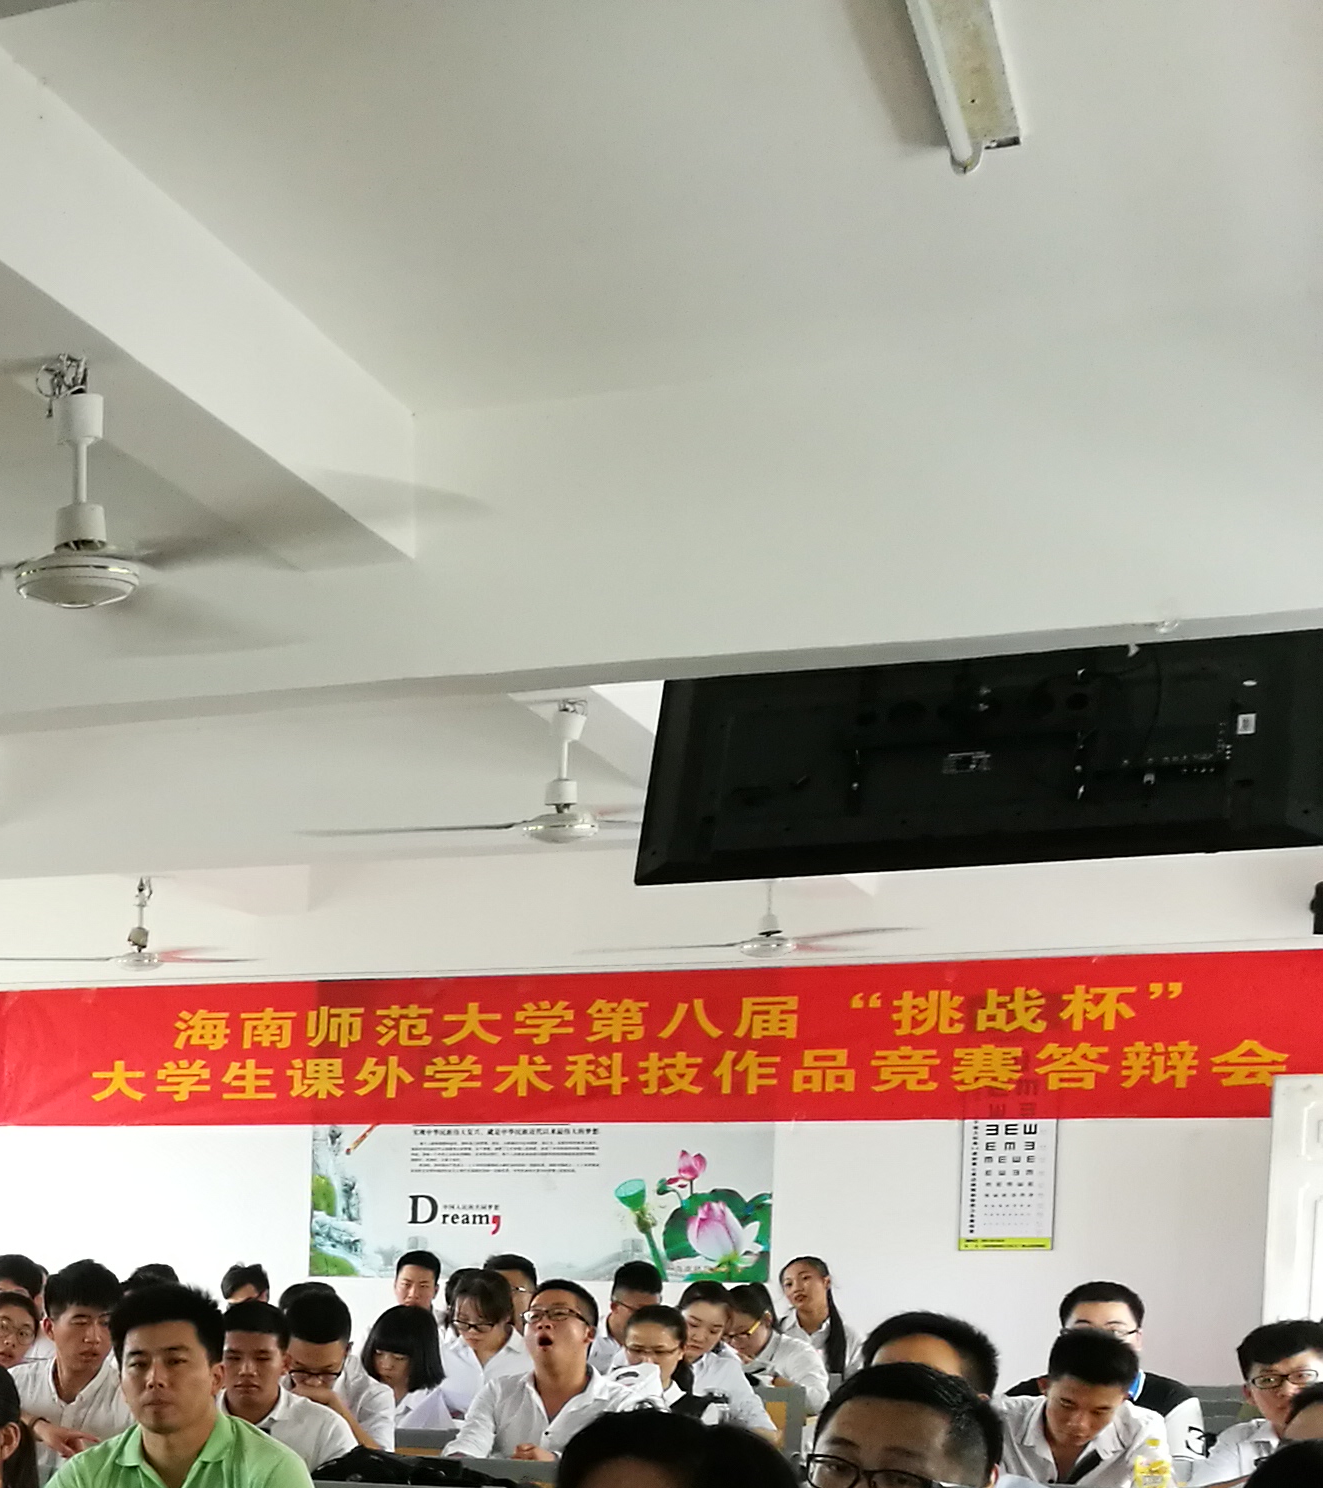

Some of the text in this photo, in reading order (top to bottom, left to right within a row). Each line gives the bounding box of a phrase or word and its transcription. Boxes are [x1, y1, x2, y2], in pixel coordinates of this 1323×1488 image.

[90, 1039, 1290, 1103] 大学生课外学术科技作品竞赛答辩会
